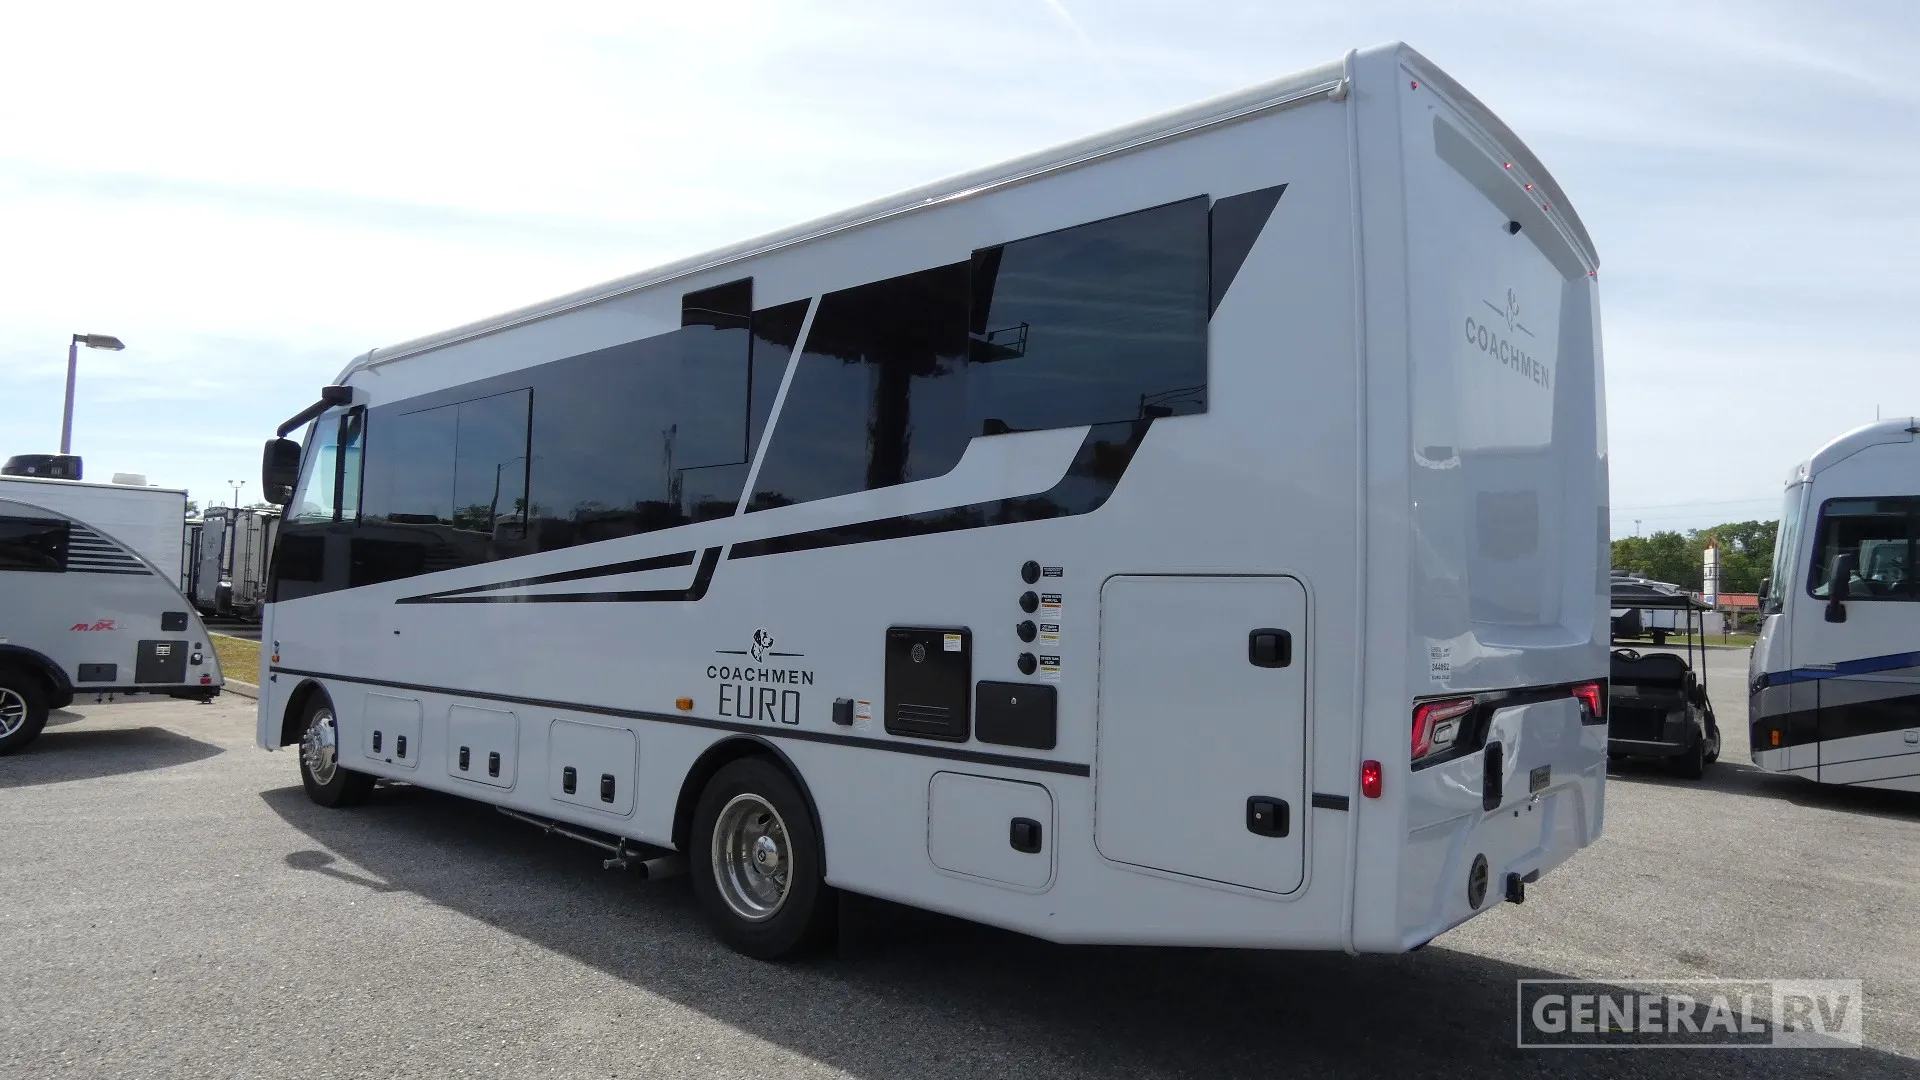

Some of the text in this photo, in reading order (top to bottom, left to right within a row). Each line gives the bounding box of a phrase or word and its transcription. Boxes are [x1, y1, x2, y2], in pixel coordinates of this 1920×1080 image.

[1465, 316, 1549, 390] COACHMEN
[706, 665, 814, 685] COACHMEN
[719, 683, 800, 725] EURO
